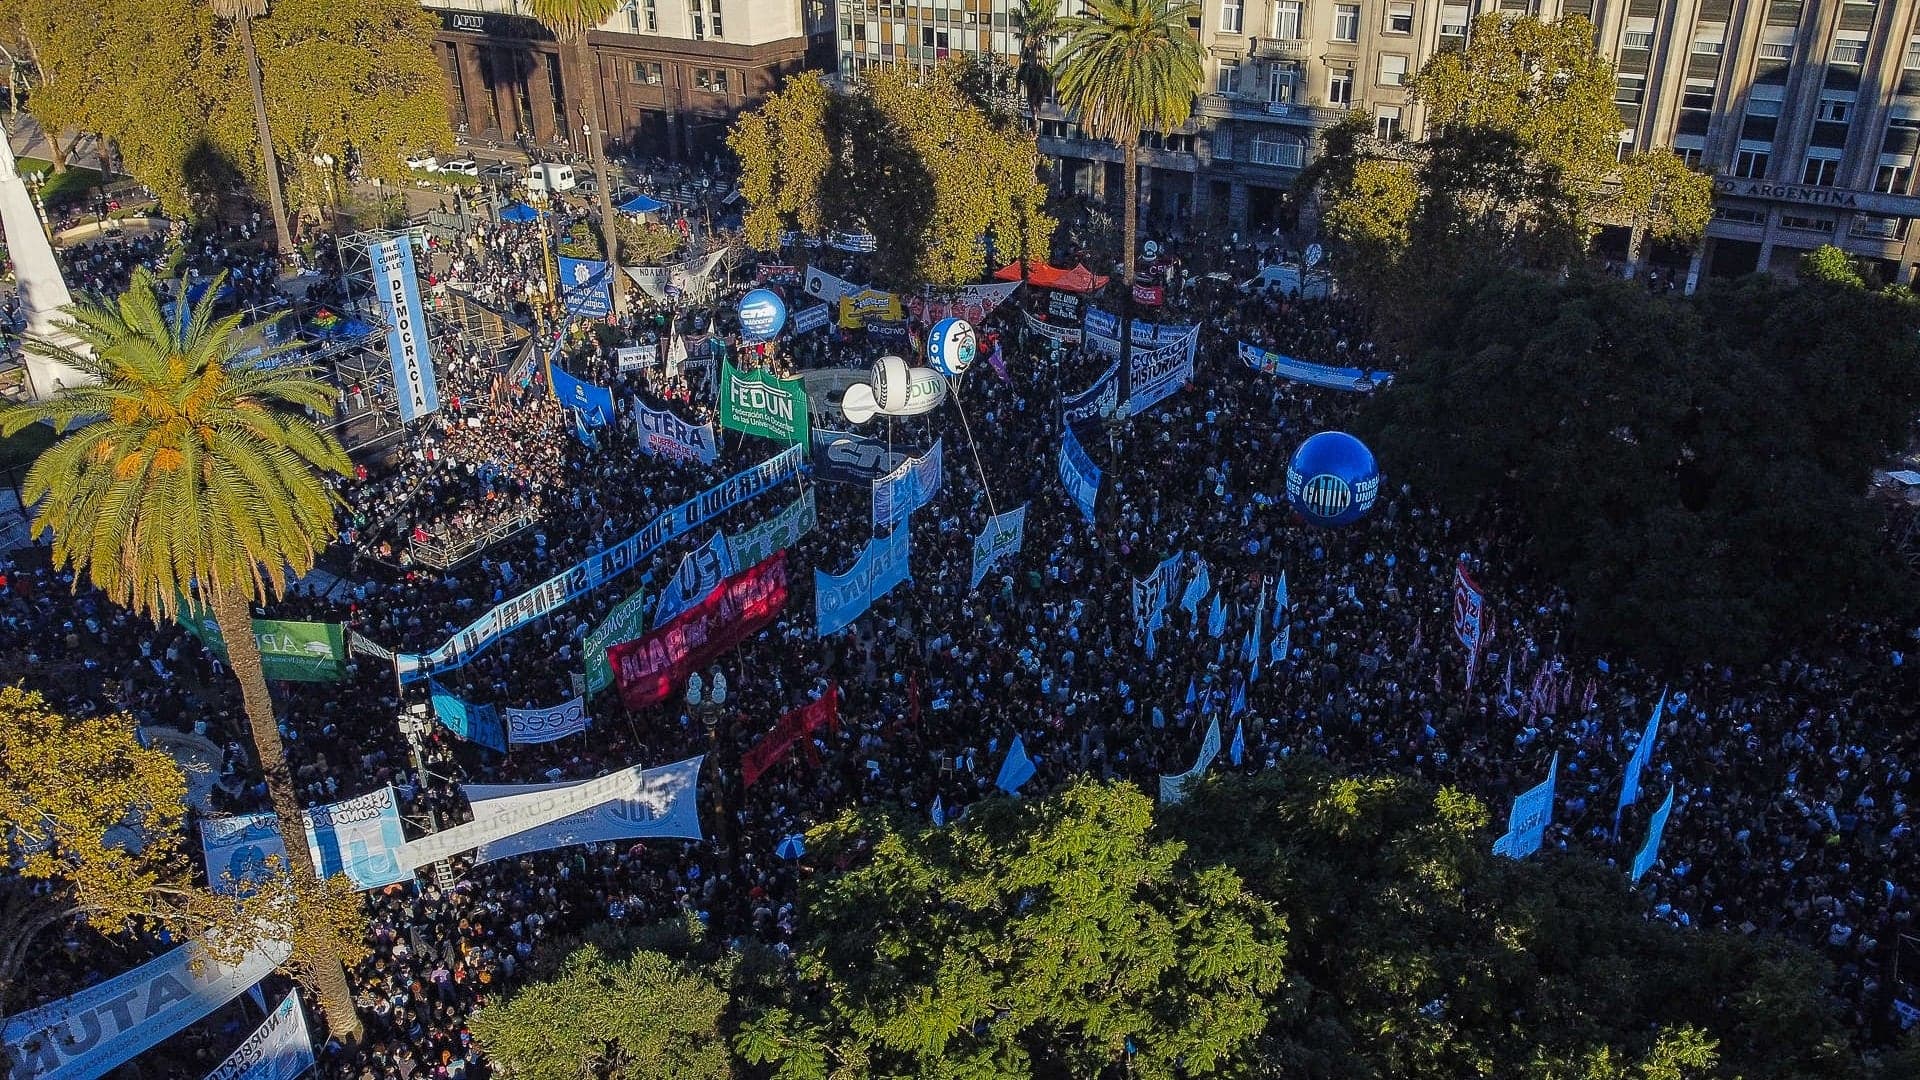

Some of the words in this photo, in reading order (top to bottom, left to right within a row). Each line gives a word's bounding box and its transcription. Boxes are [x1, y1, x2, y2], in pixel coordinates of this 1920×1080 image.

[1748, 184, 1858, 206] ARGENTINA
[381, 264, 391, 273] LA
[392, 261, 405, 270] LEY
[639, 268, 649, 277] NO
[391, 279, 423, 408] DEMOCRACIA
[911, 379, 941, 398] DUN
[731, 382, 793, 421] FEDUN
[640, 407, 706, 449] CTERA
